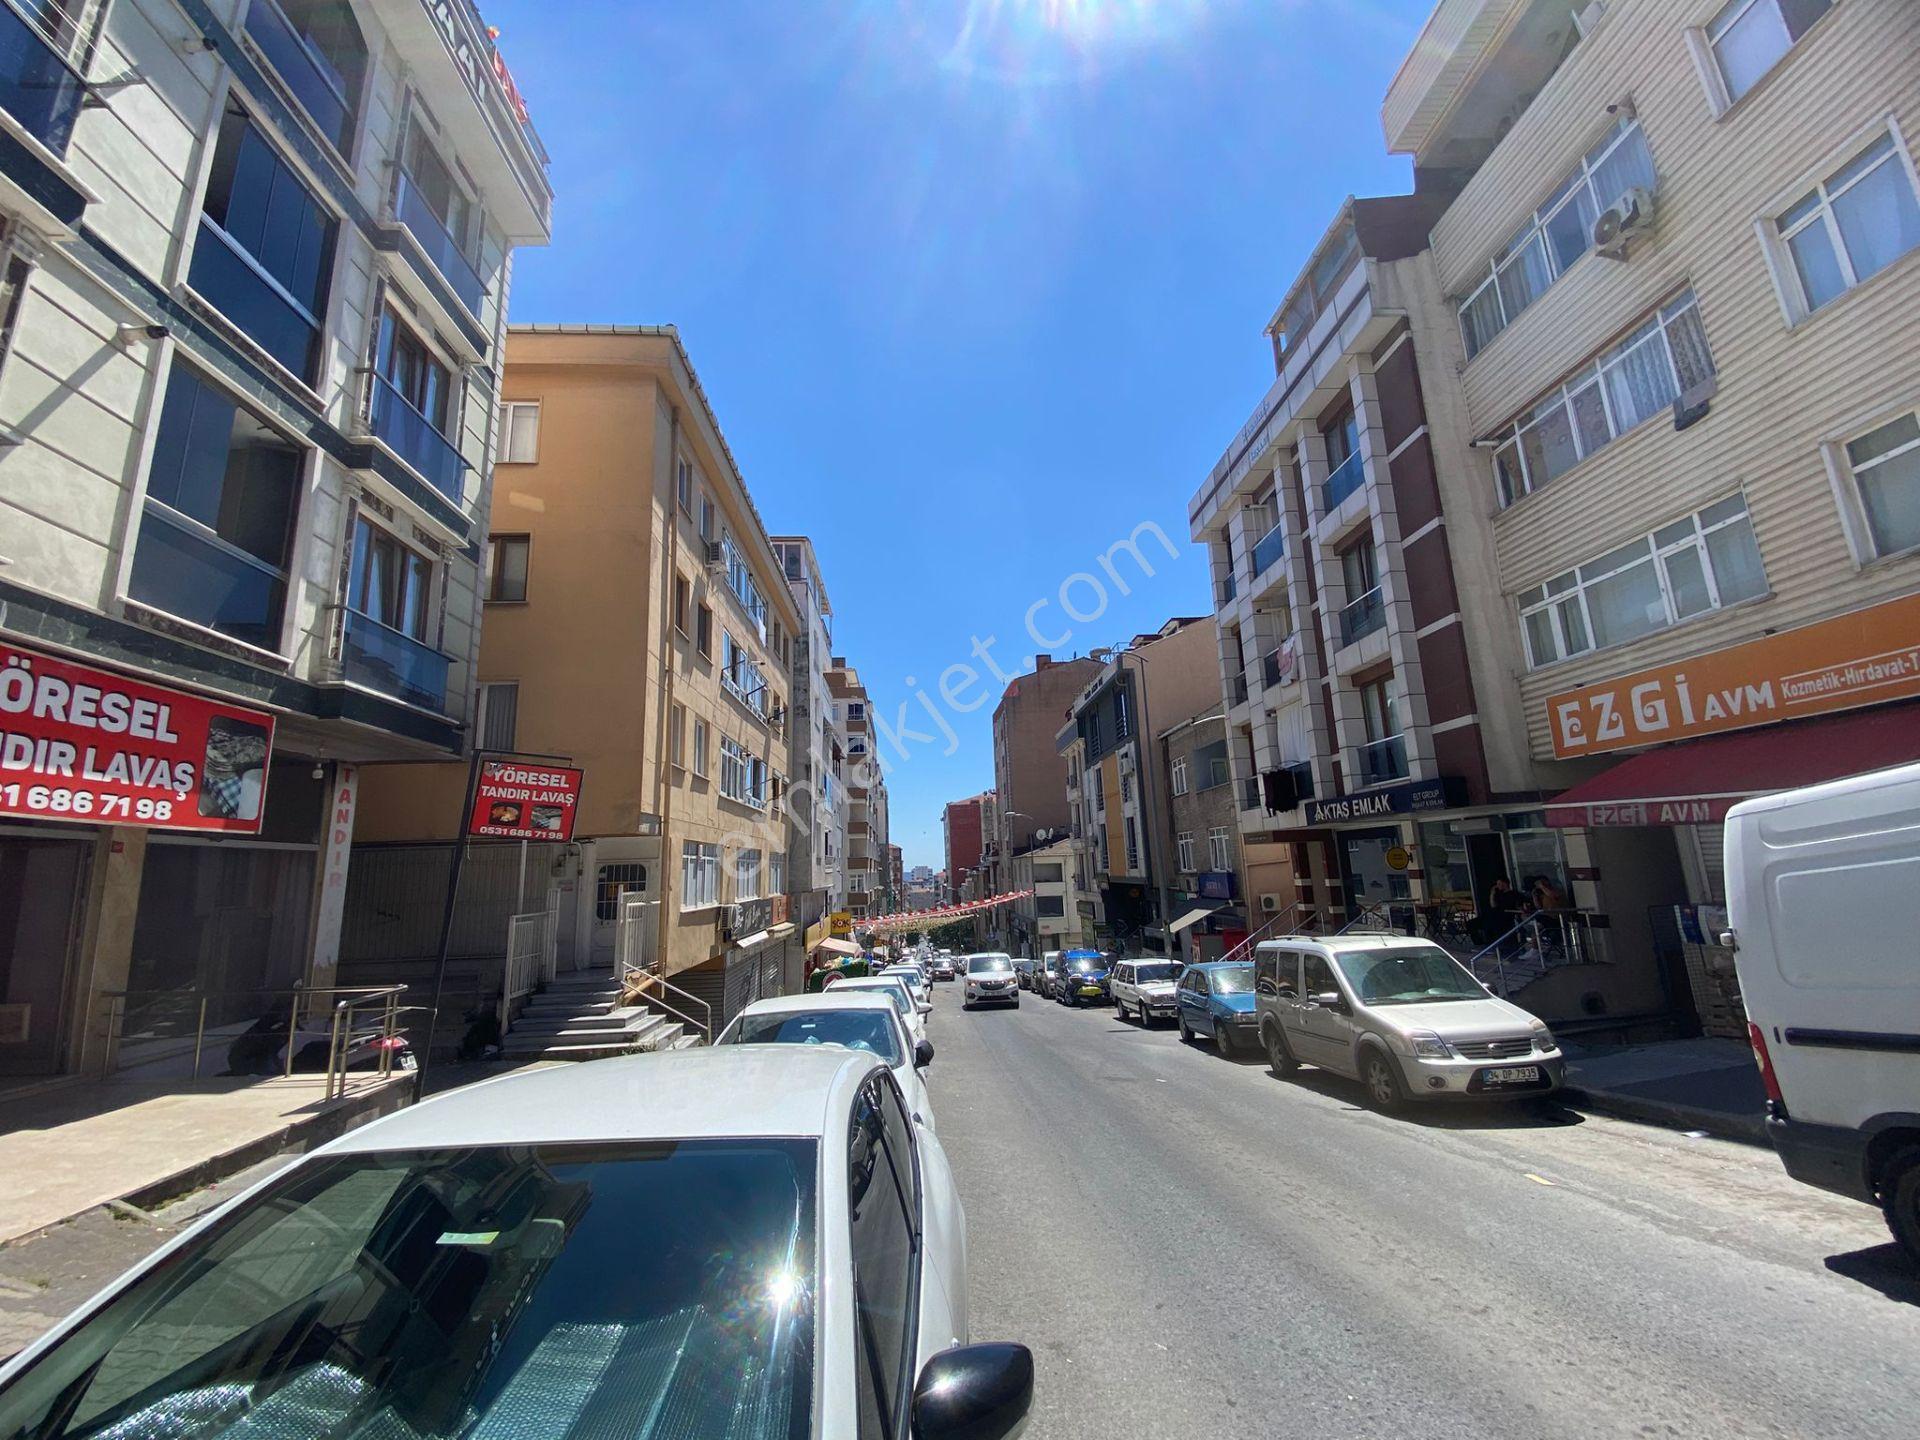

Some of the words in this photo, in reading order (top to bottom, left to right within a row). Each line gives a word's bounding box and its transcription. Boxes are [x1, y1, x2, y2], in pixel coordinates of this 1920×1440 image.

[0, 656, 178, 744] ÖRESEL
[1556, 674, 1698, 749] EZGİ
[1703, 680, 1776, 722] AVM
[0, 731, 77, 778] DIR
[82, 747, 196, 801] LAVAŞ
[493, 766, 570, 788] YÖRESEL
[0, 783, 21, 808] 1
[27, 785, 94, 814] 686
[481, 785, 530, 800] TANDIR
[532, 790, 575, 806] LAVAŞ
[1352, 794, 1392, 816] EMLAK
[1660, 802, 1711, 823] AVM
[479, 826, 507, 835] 0531
[509, 828, 532, 837] 686
